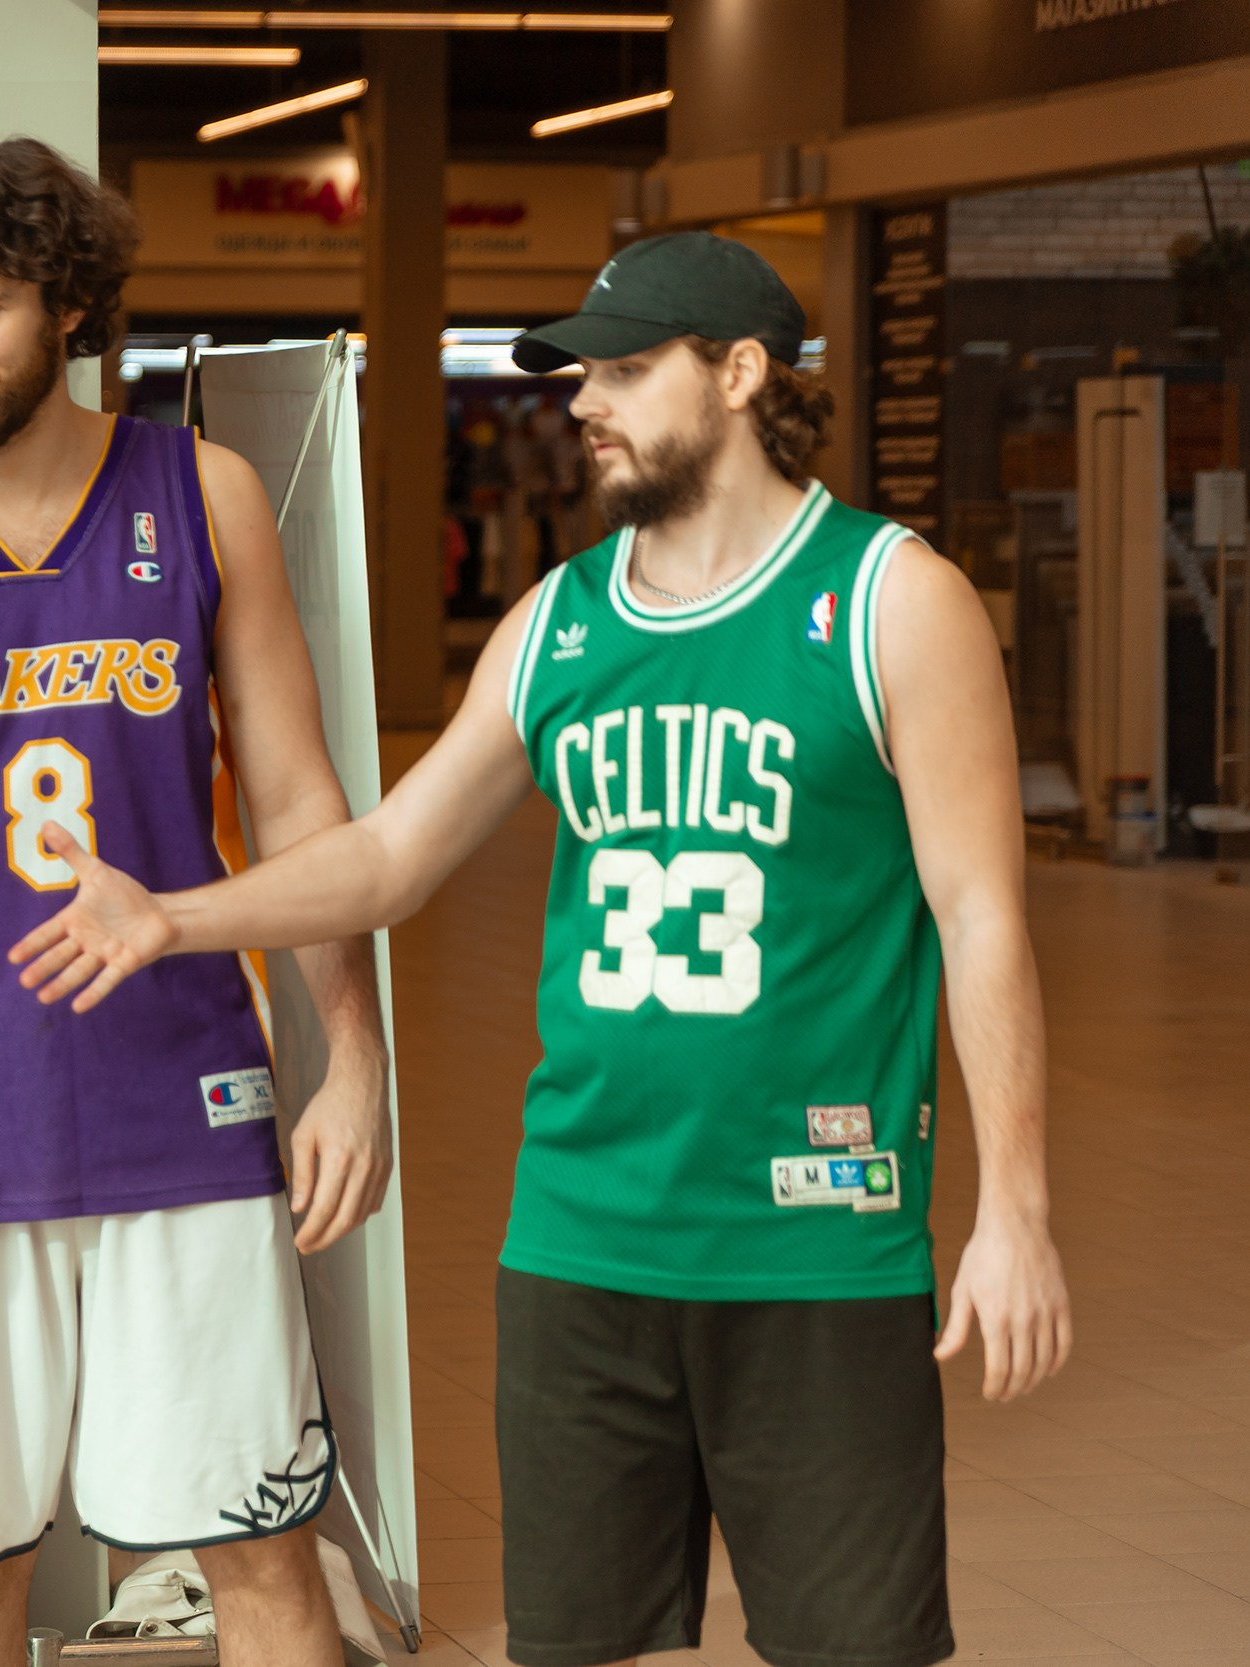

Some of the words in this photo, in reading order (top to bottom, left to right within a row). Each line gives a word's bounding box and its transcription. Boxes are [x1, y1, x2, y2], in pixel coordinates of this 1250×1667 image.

[3, 737, 98, 892] 8
[554, 703, 796, 848] CELTICS
[578, 848, 765, 1015] 33
[254, 1085, 269, 1099] XL
[804, 1166, 820, 1185] M
